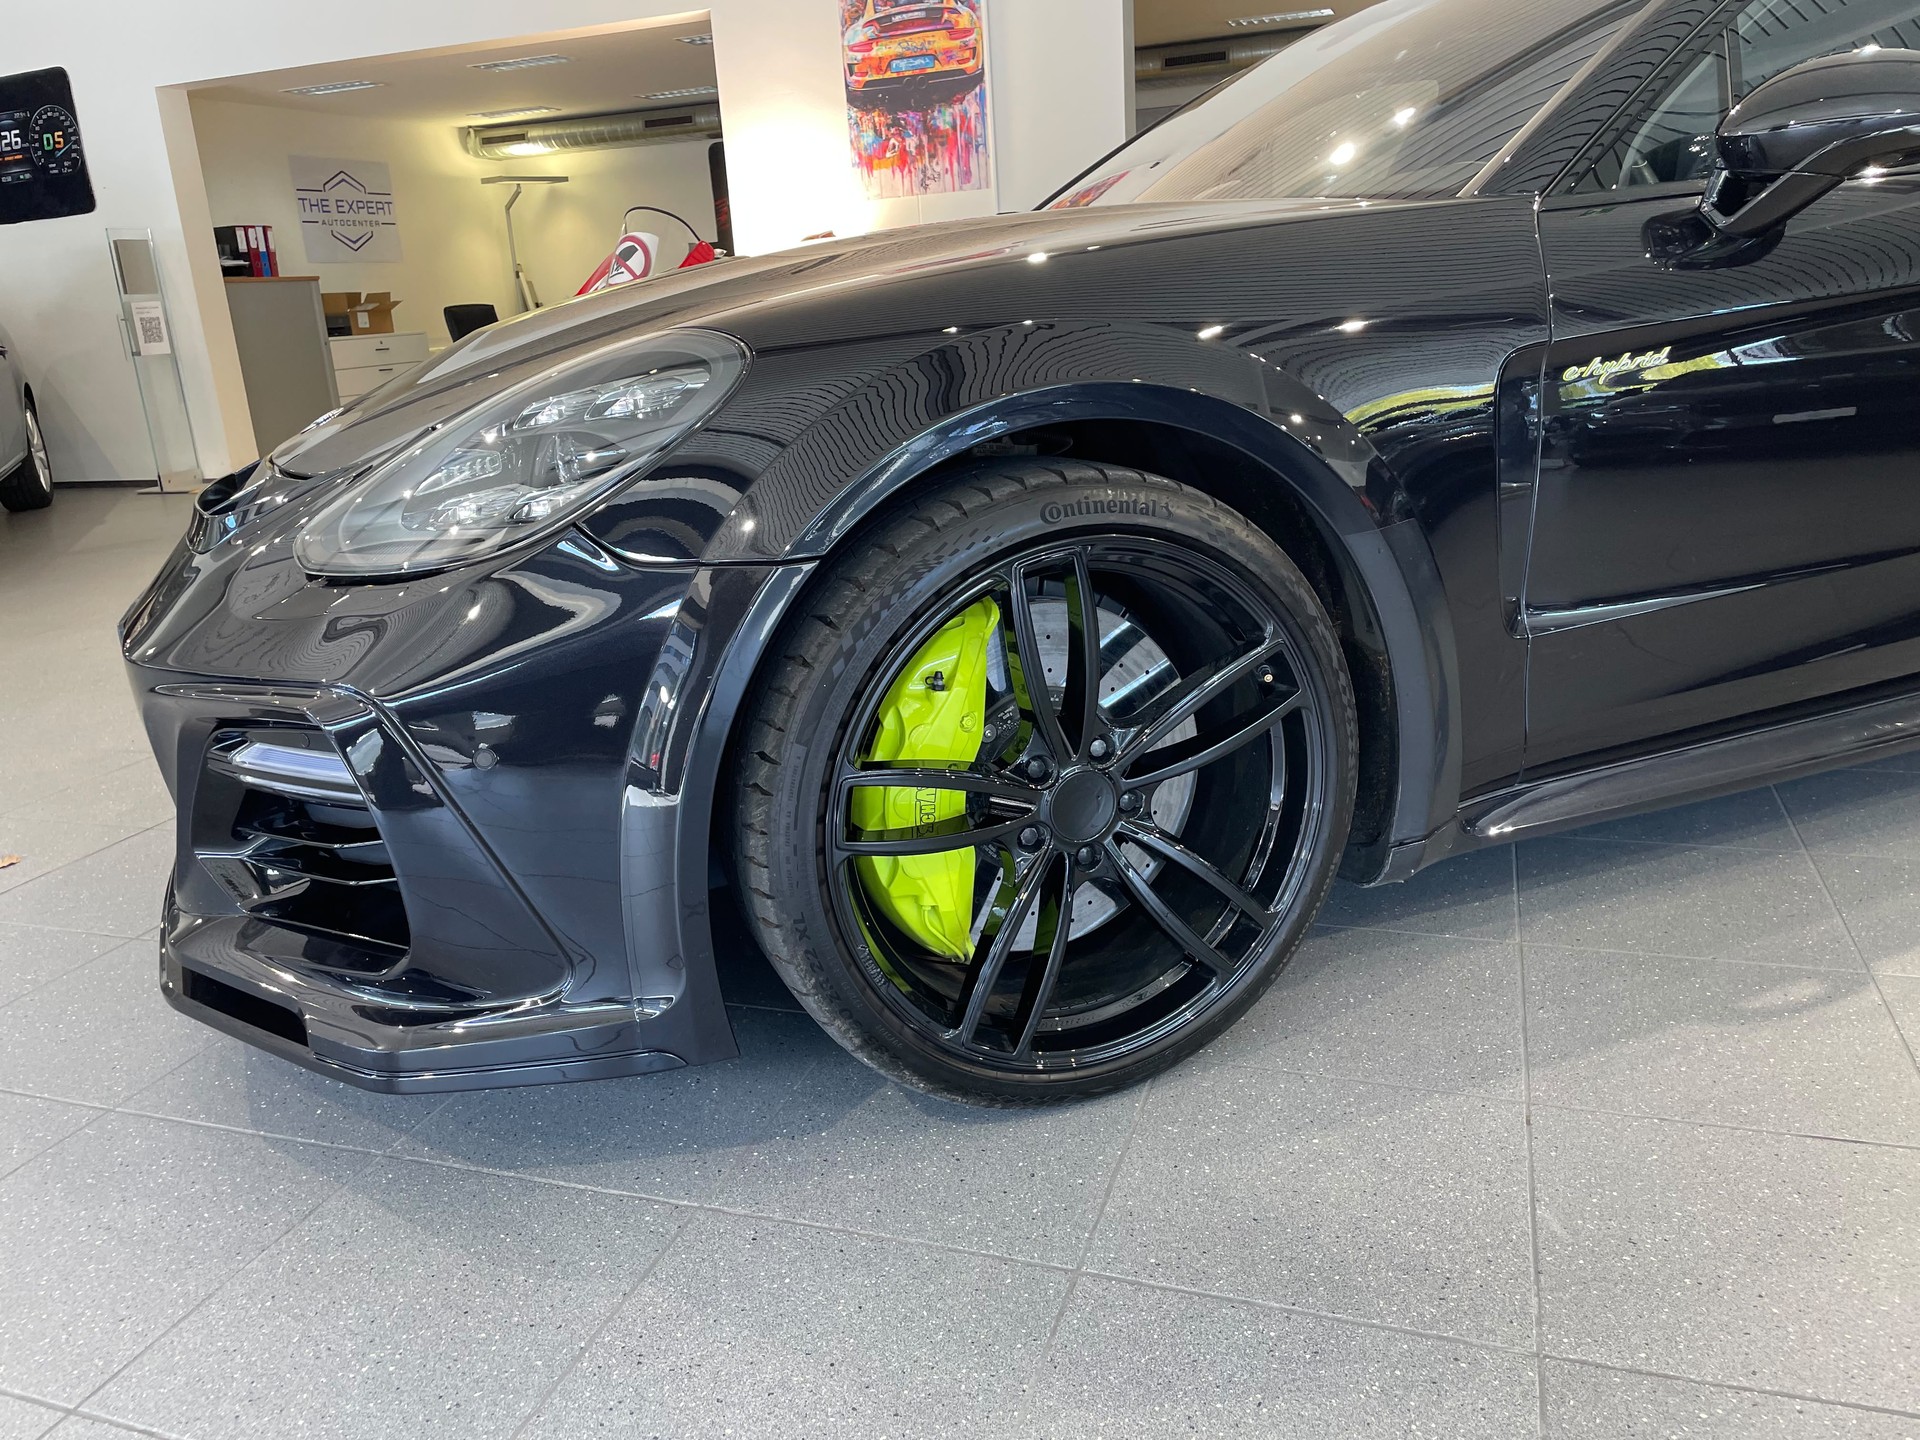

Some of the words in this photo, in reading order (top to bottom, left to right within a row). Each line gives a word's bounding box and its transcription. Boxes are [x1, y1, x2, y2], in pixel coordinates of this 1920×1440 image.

[298, 198, 331, 213] THE
[335, 199, 393, 215] EXPERT
[321, 219, 381, 227] AUTOCENTER
[1040, 496, 1157, 525] Continental
